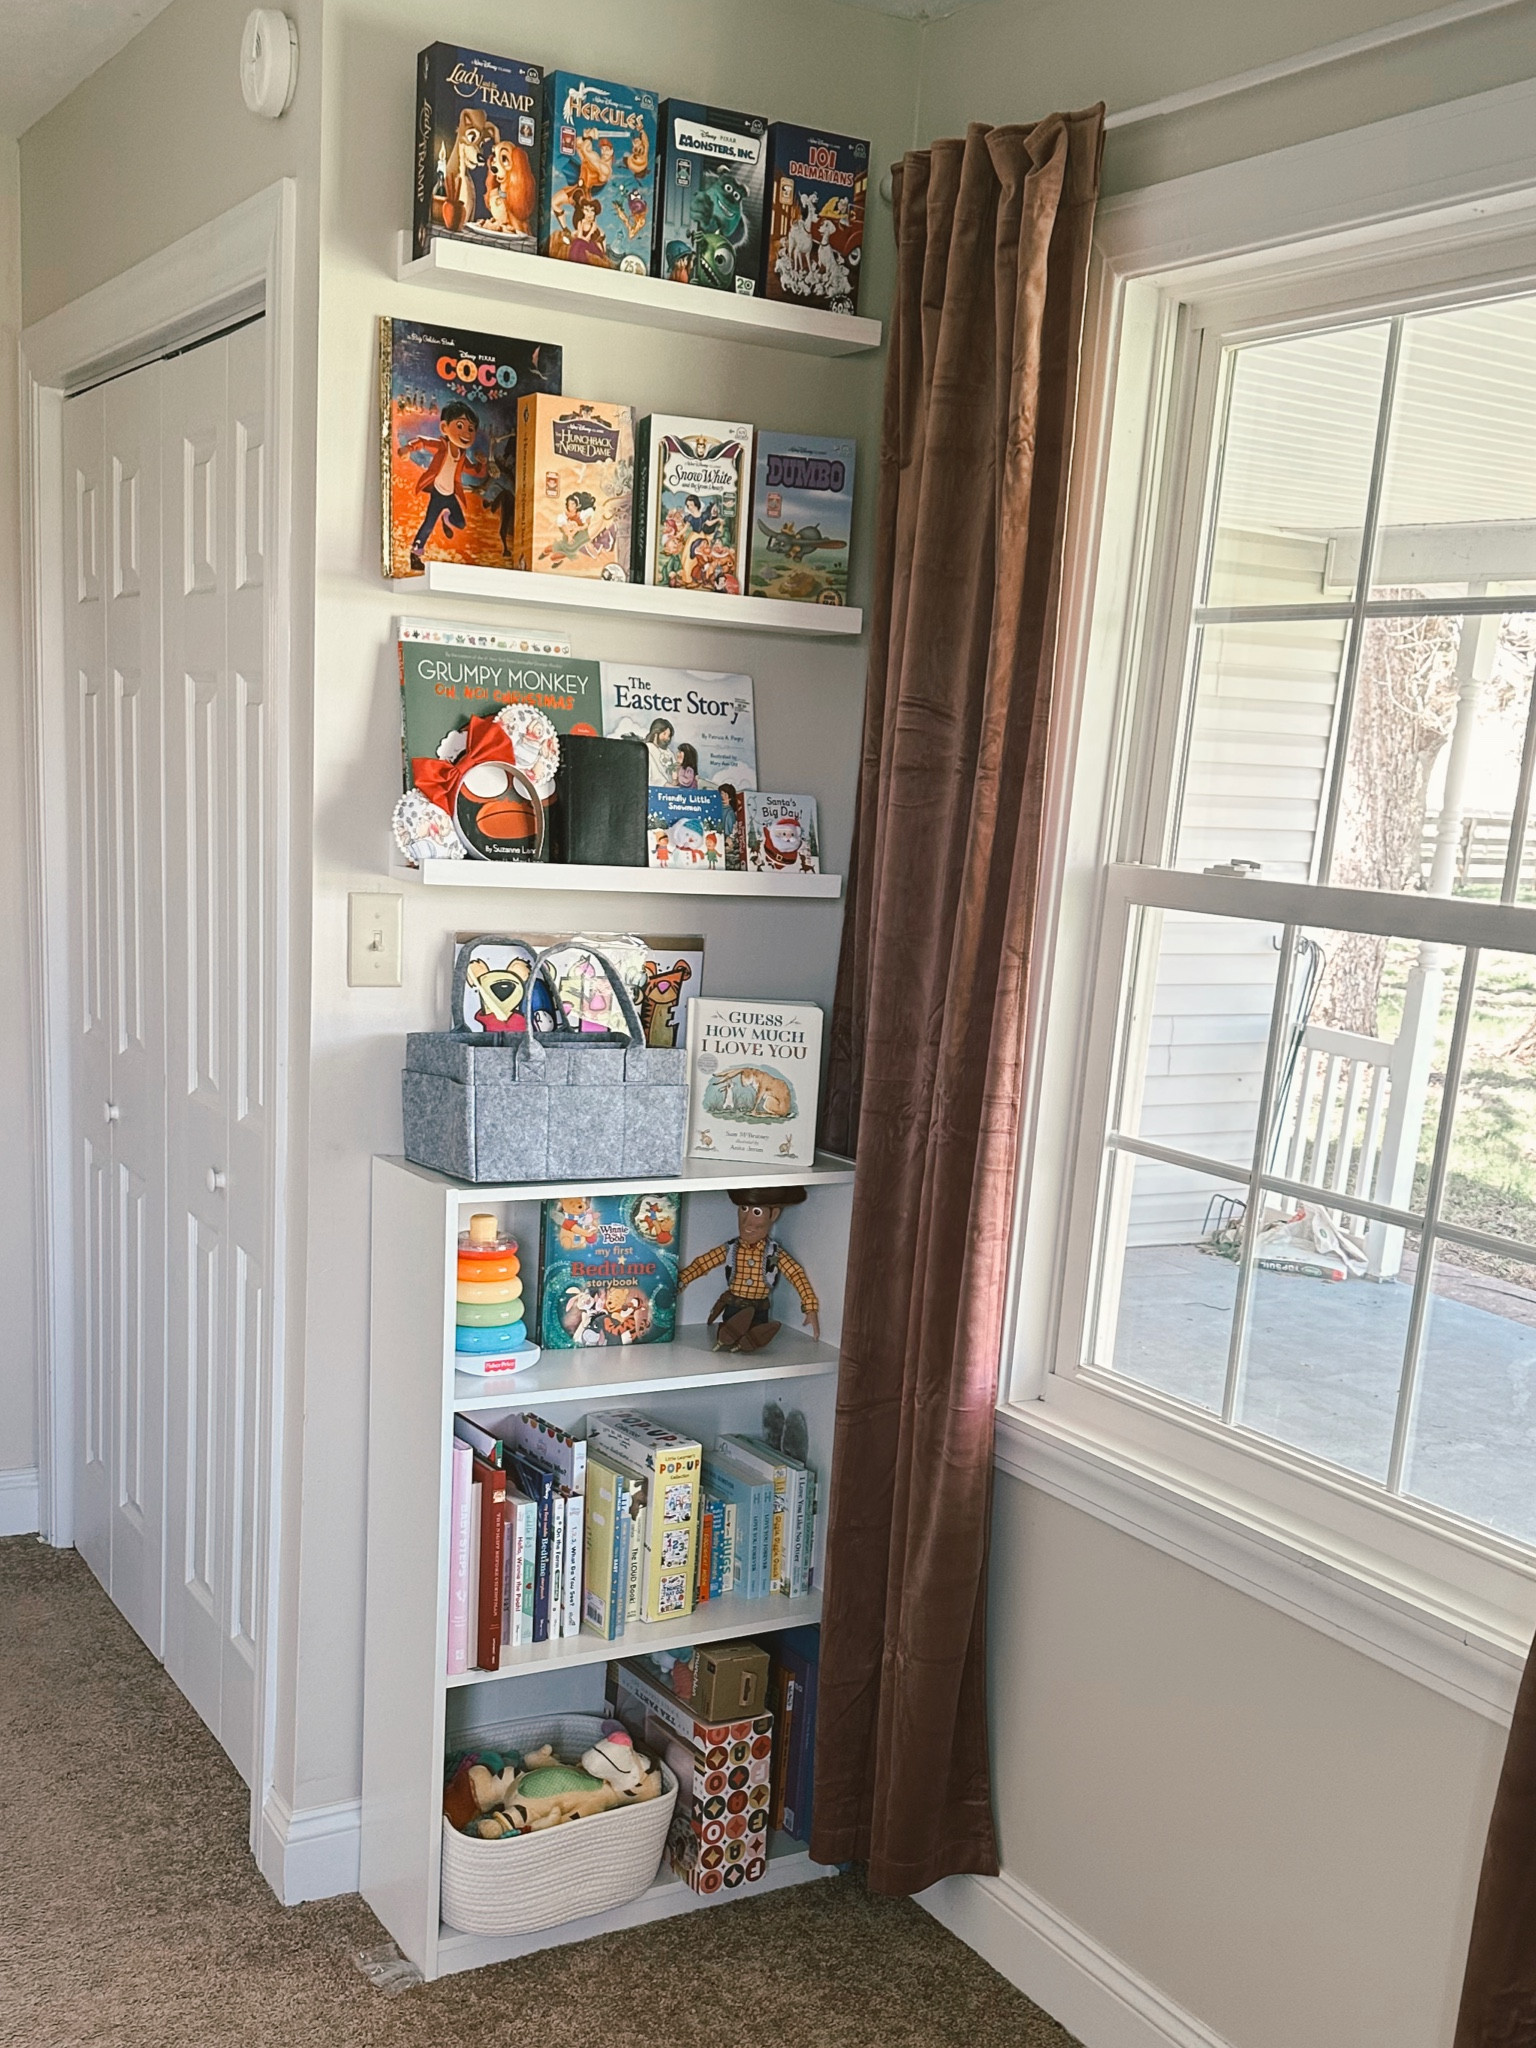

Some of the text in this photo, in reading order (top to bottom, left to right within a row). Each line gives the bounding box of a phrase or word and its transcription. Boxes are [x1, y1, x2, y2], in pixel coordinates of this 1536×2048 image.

[446, 63, 484, 95] Lady
[480, 85, 534, 113] TRAMP
[569, 96, 644, 131] HERCULES
[679, 133, 755, 160] MONSTERS, INC.
[720, 135, 737, 143] PIXAR
[809, 146, 837, 169] 101
[417, 139, 427, 203] TRAMP
[789, 160, 854, 187] DALMATIANS
[436, 355, 518, 389] COCO
[561, 429, 615, 450] HUNCHBACK
[586, 444, 611, 457] DAME
[669, 464, 732, 486] Snow White
[766, 454, 845, 493] DUMBO
[417, 660, 503, 687] GRUMPY
[508, 668, 589, 695] MONKEY
[628, 676, 651, 691] The
[435, 683, 576, 711] OH, NO! CHRISTMAS
[614, 683, 682, 713] Easter
[658, 793, 711, 804] Friendly Little
[767, 796, 797, 807] Santa's
[668, 803, 701, 812] Snowman
[762, 807, 803, 821] Big Day!
[492, 844, 521, 854] Suzanne
[729, 1011, 783, 1027] GUESS
[706, 1025, 805, 1043] HOW MUCH
[701, 1039, 808, 1060] I LOVE YOU
[600, 1226, 629, 1234] Winnie
[603, 1233, 625, 1243] Pooh
[595, 1245, 634, 1257] my first
[571, 1260, 656, 1277] Bedtime
[586, 1277, 639, 1288] storybook
[659, 1459, 700, 1474] POP-UP
[544, 1483, 552, 1500] Disney
[555, 1527, 562, 1536] On
[795, 1531, 802, 1543] No
[539, 1537, 549, 1576] Bedtime
[631, 1548, 639, 1560] The
[723, 1537, 733, 1575] HUGS
[571, 1566, 576, 1575] Do
[630, 1562, 638, 1582] LOUD
[629, 1584, 637, 1604] Book!
